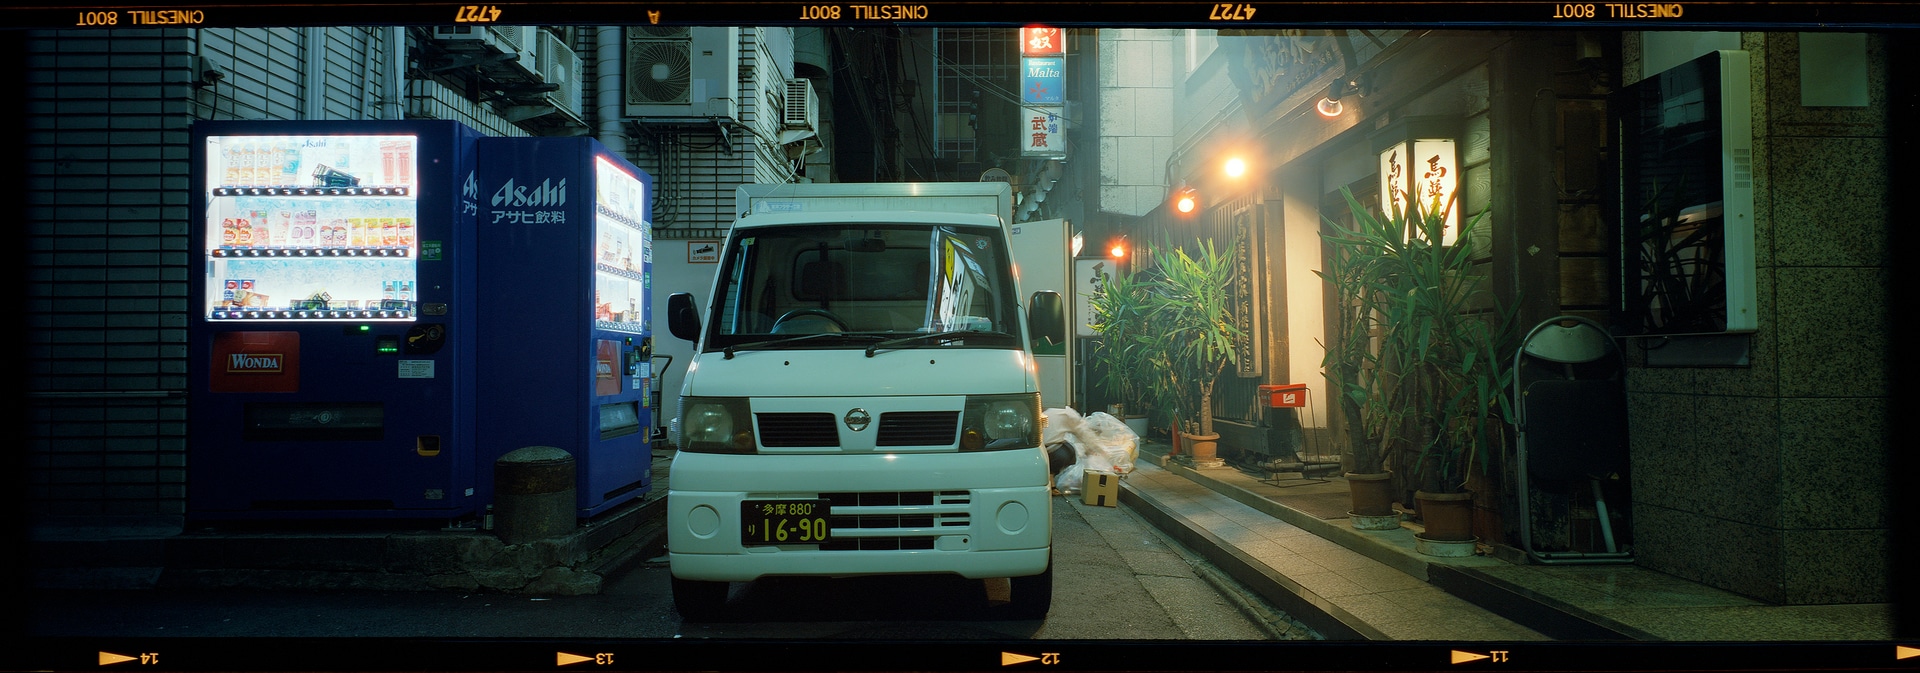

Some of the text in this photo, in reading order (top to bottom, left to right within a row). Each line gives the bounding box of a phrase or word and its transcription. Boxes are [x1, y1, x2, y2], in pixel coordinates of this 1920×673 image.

[1027, 67, 1060, 78] Malta
[1031, 116, 1048, 148] 武蔵
[491, 177, 566, 207] Asahi
[491, 210, 566, 224] アサヒ飲料
[231, 353, 279, 369] WONDA
[762, 503, 812, 515] 多摩 880
[748, 518, 827, 541] り 16-90
